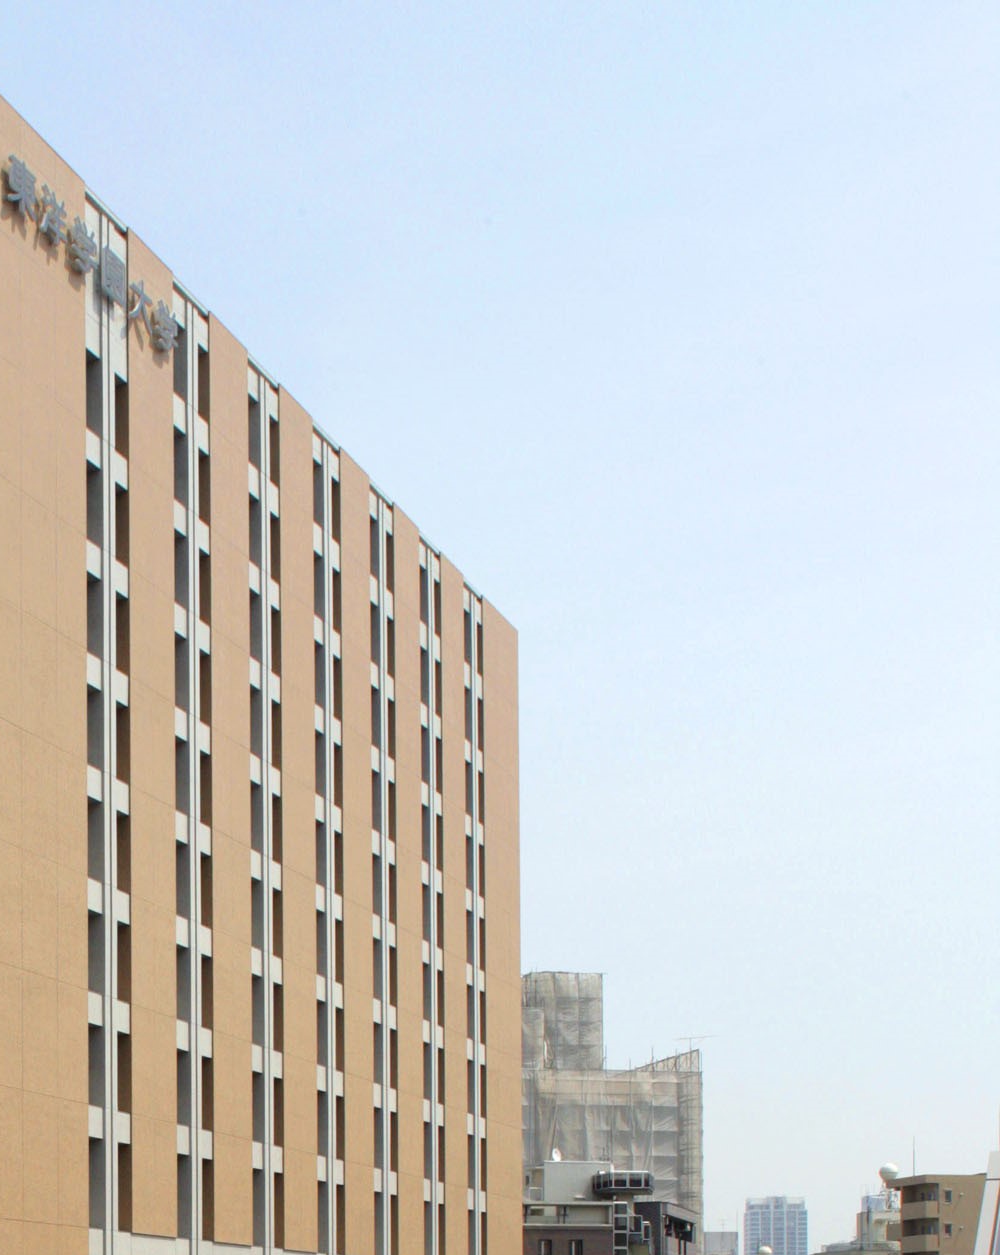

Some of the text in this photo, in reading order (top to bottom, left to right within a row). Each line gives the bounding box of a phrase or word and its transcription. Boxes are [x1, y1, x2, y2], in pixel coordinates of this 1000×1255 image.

[7, 154, 179, 352] 東洋学園大学
